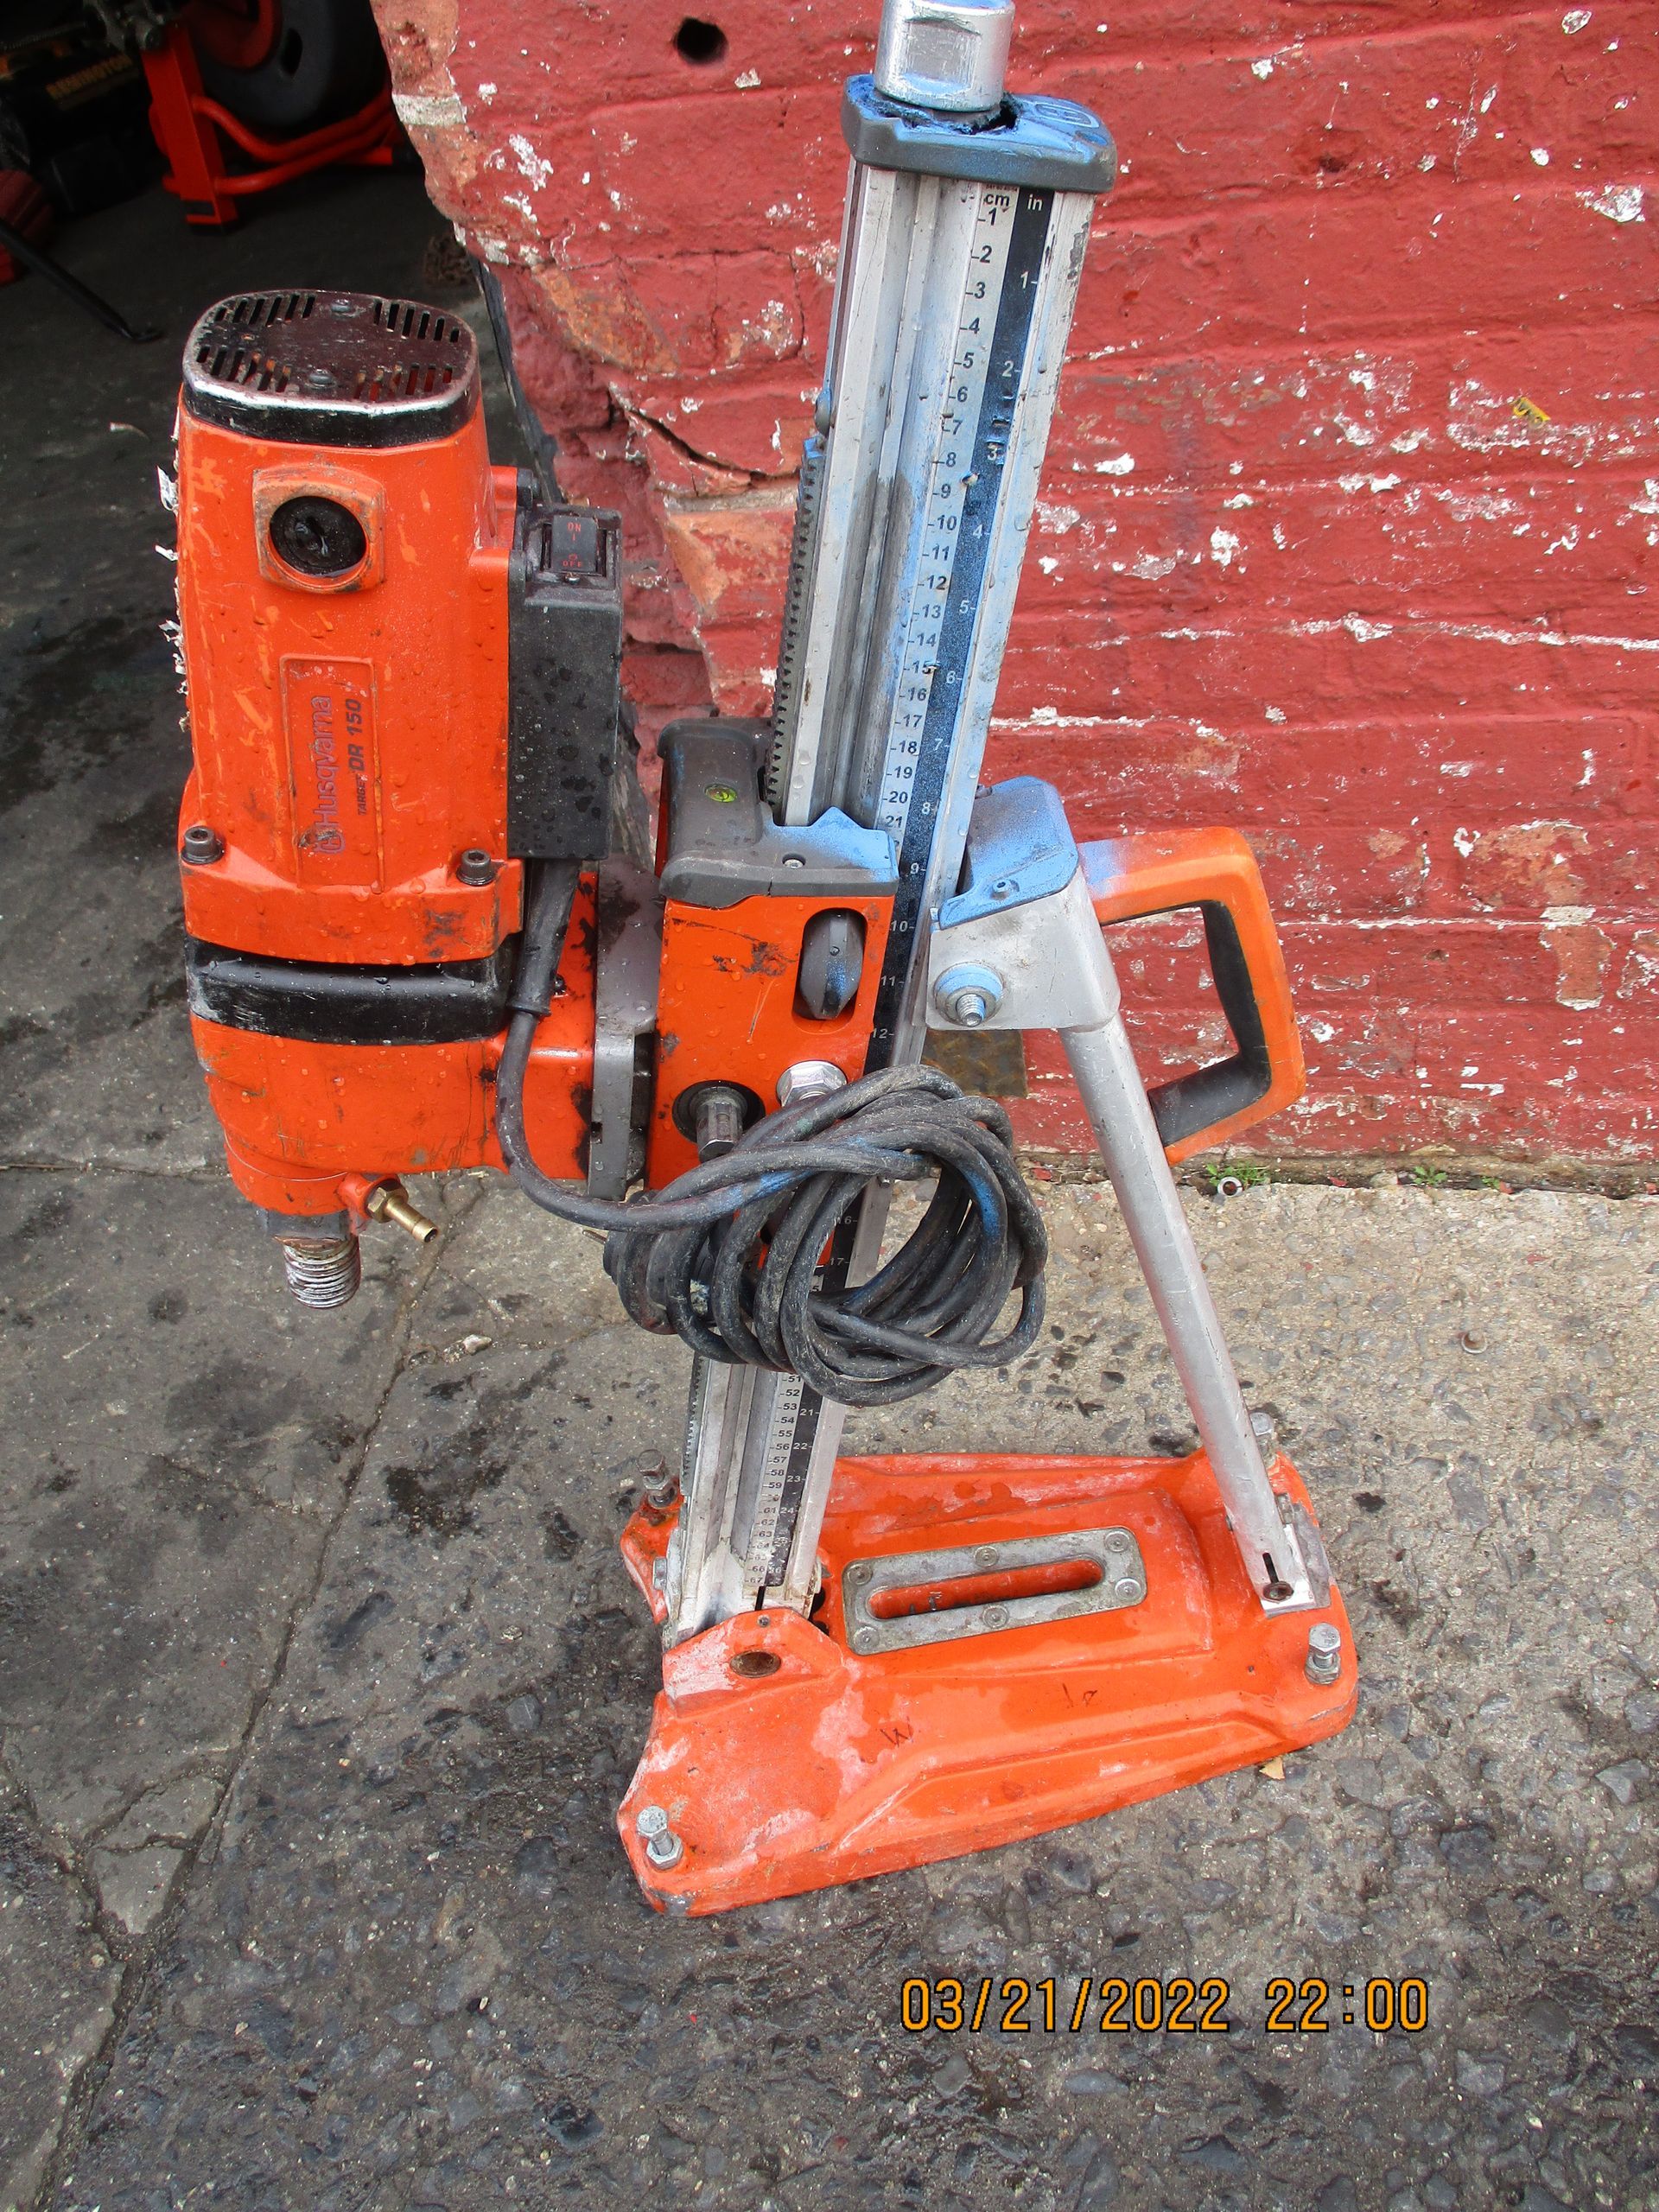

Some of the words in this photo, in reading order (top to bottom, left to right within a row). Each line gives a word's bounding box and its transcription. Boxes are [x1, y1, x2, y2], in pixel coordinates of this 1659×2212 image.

[984, 194, 1010, 207] cm
[1027, 194, 1043, 211] in
[988, 207, 998, 226] 1
[979, 245, 993, 264] 2
[1020, 270, 1029, 289] 1
[974, 281, 986, 299] 3
[968, 317, 981, 335] 4
[962, 352, 975, 369] 5
[1001, 359, 1014, 378] 2
[957, 385, 969, 403] 6
[952, 419, 963, 435] 7
[945, 451, 957, 468] 8
[941, 483, 951, 499] 9
[567, 522, 582, 532] ON
[937, 514, 957, 531] 10
[972, 524, 983, 540] 4
[931, 544, 950, 562] 11
[926, 574, 947, 591] 12
[922, 603, 942, 619] 13
[959, 600, 970, 613] 5
[917, 632, 937, 648] 14
[907, 687, 927, 702] 16
[345, 698, 363, 736] 150
[903, 714, 923, 728] 17
[899, 740, 918, 754] 18
[934, 738, 944, 751] 7
[311, 695, 339, 829] Husqvarna
[347, 743, 365, 772] DR
[894, 766, 913, 779] 19
[888, 791, 908, 804] 20
[921, 802, 931, 815] 8
[885, 815, 903, 829] 21
[910, 862, 919, 874] 9
[891, 919, 908, 932] 10
[880, 975, 896, 987] 11
[873, 1027, 887, 1039] 12
